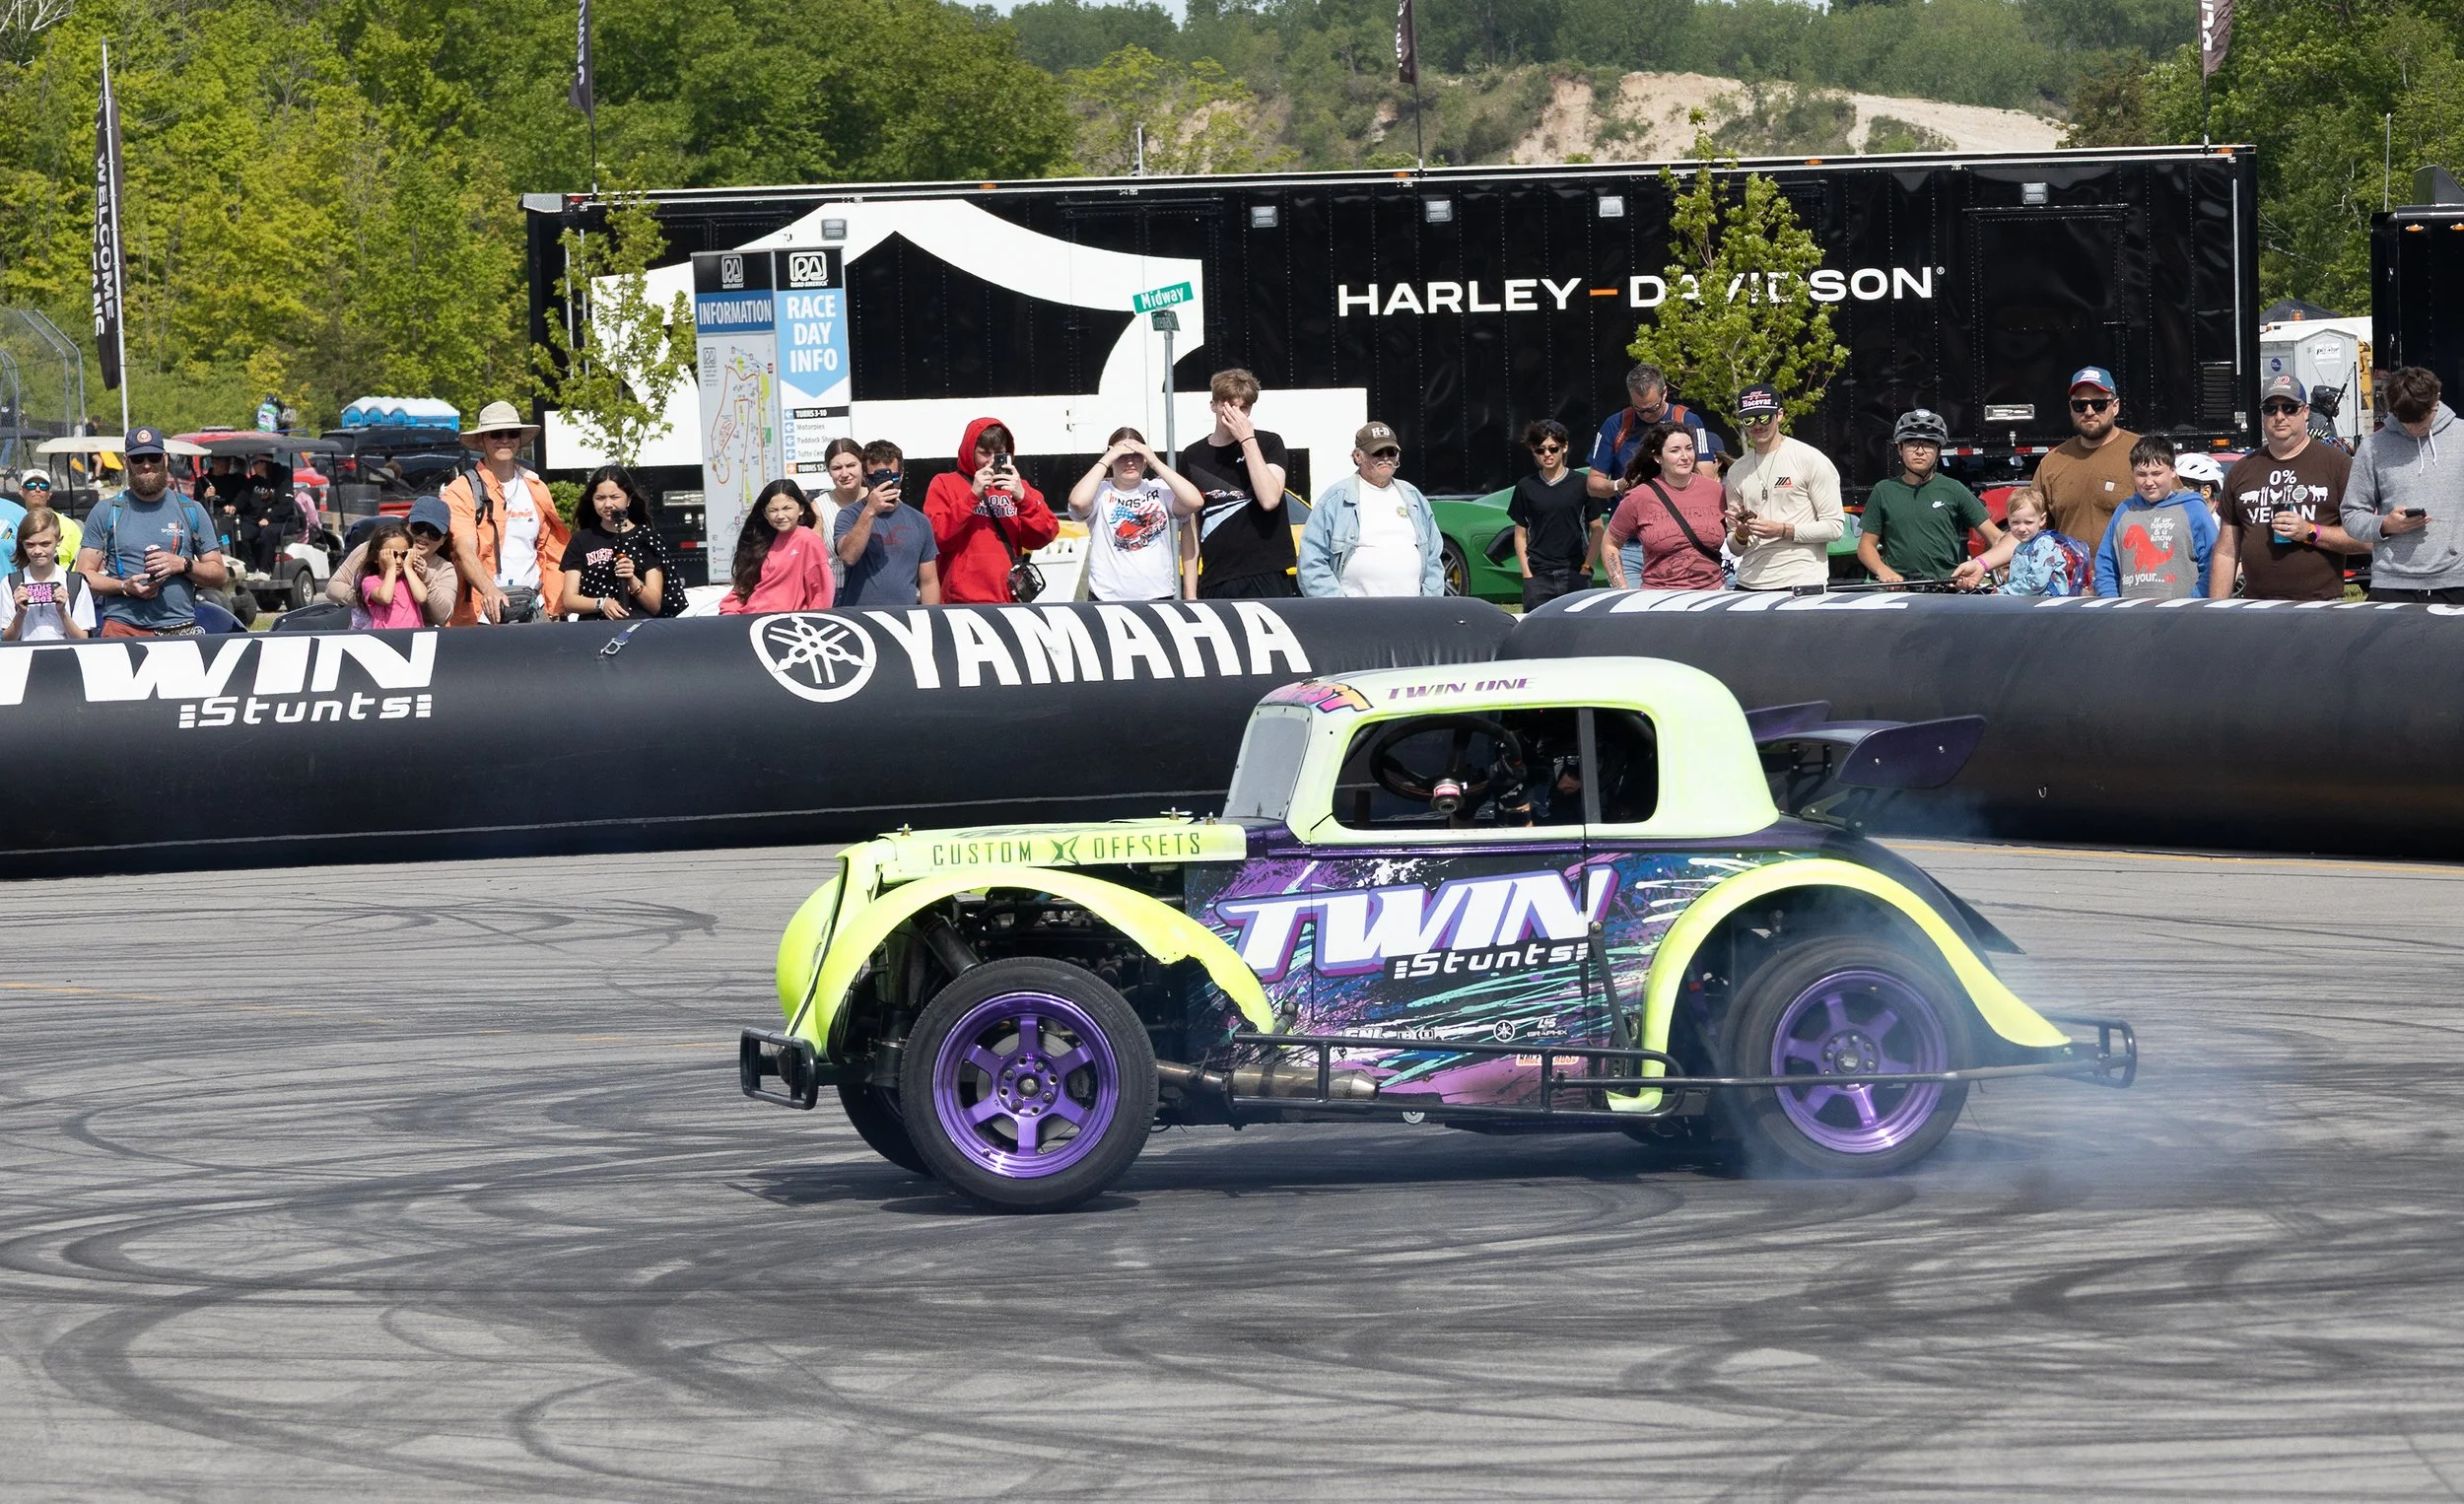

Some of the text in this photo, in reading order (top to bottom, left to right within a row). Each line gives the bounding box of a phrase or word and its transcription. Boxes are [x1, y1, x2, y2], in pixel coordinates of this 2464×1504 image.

[98, 152, 114, 320] WELCOME
[787, 295, 836, 319] RACE
[1140, 287, 1183, 309] Midway
[699, 300, 772, 325] INFORMATION
[793, 321, 832, 345] DAY
[789, 349, 838, 374] INFO
[1371, 427, 1390, 439] H-D
[2269, 469, 2296, 485] 0%
[862, 601, 1312, 690] YAMAHA
[1389, 683, 1466, 700] TWIN
[1474, 677, 1538, 692] ONE
[196, 692, 412, 728] Stunts
[932, 841, 1032, 866] CUSTOM
[1094, 832, 1200, 860] OFFSETS
[1222, 867, 1616, 971] TWIN
[1407, 942, 1578, 976] Stunts
